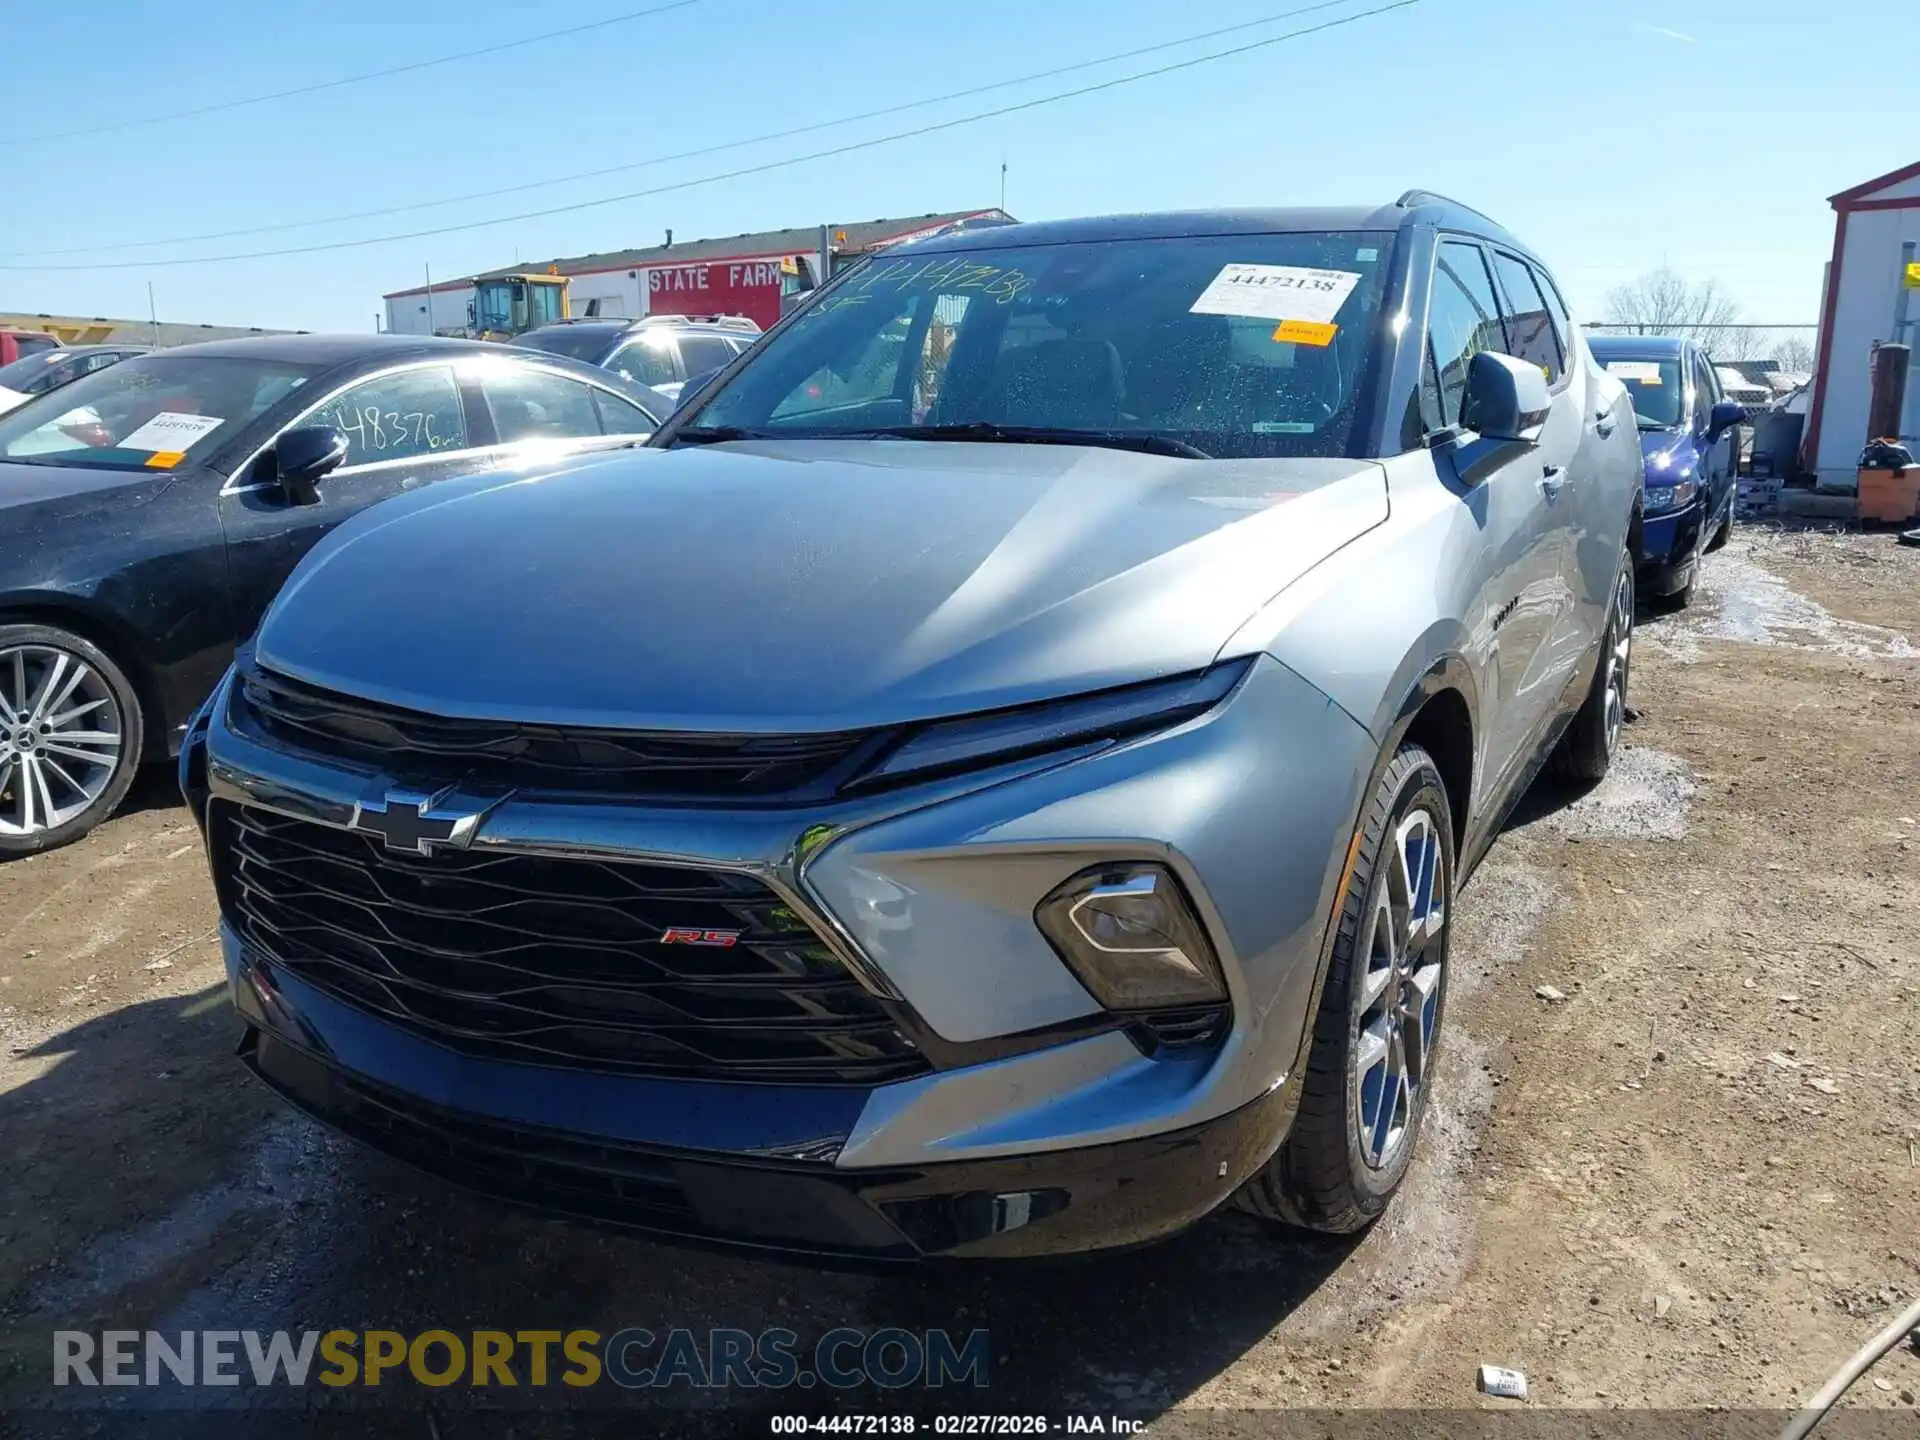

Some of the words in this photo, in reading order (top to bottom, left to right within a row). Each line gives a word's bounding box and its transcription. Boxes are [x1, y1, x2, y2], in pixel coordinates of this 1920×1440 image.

[649, 267, 709, 292] STATE
[729, 262, 781, 288] FARM
[1228, 274, 1337, 292] 44472138
[660, 927, 740, 947] RS
